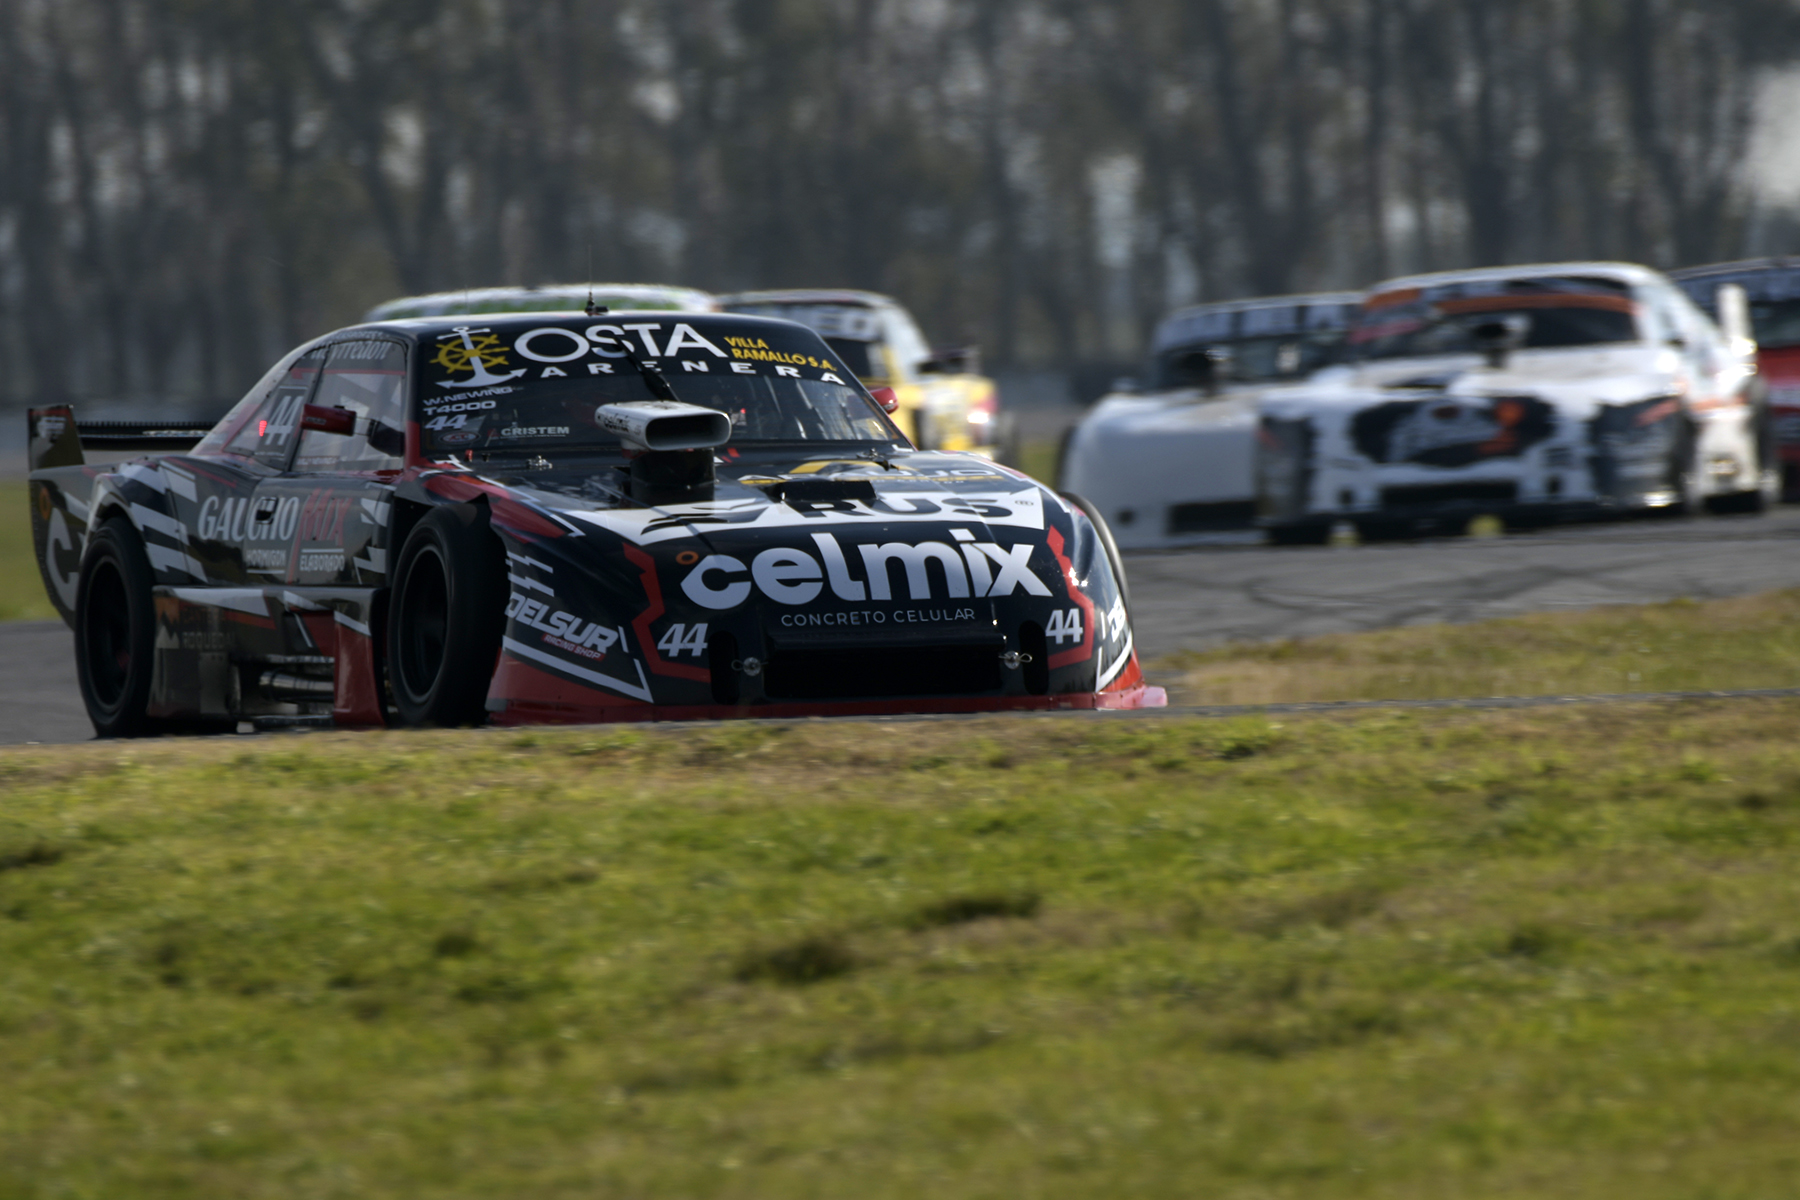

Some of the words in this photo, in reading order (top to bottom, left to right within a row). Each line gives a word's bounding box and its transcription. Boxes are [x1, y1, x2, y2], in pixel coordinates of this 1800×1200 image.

[723, 336, 770, 350] VILLA
[731, 348, 807, 366] RAMALLO
[807, 355, 838, 372] S.A.
[422, 386, 514, 406] W.NEWING
[422, 400, 497, 416] T4000
[264, 395, 304, 446] 44
[424, 413, 468, 431] 44
[500, 426, 570, 437] CRISTEM
[197, 495, 300, 542] GAUCHO
[680, 528, 1053, 610] celmix
[505, 591, 619, 654] DELSUR
[780, 610, 886, 627] CONCRETO
[892, 608, 976, 624] CELULAR
[1045, 607, 1083, 645] 44
[543, 634, 575, 654] RACING
[574, 646, 604, 661] SHOP
[656, 622, 708, 658] 44
